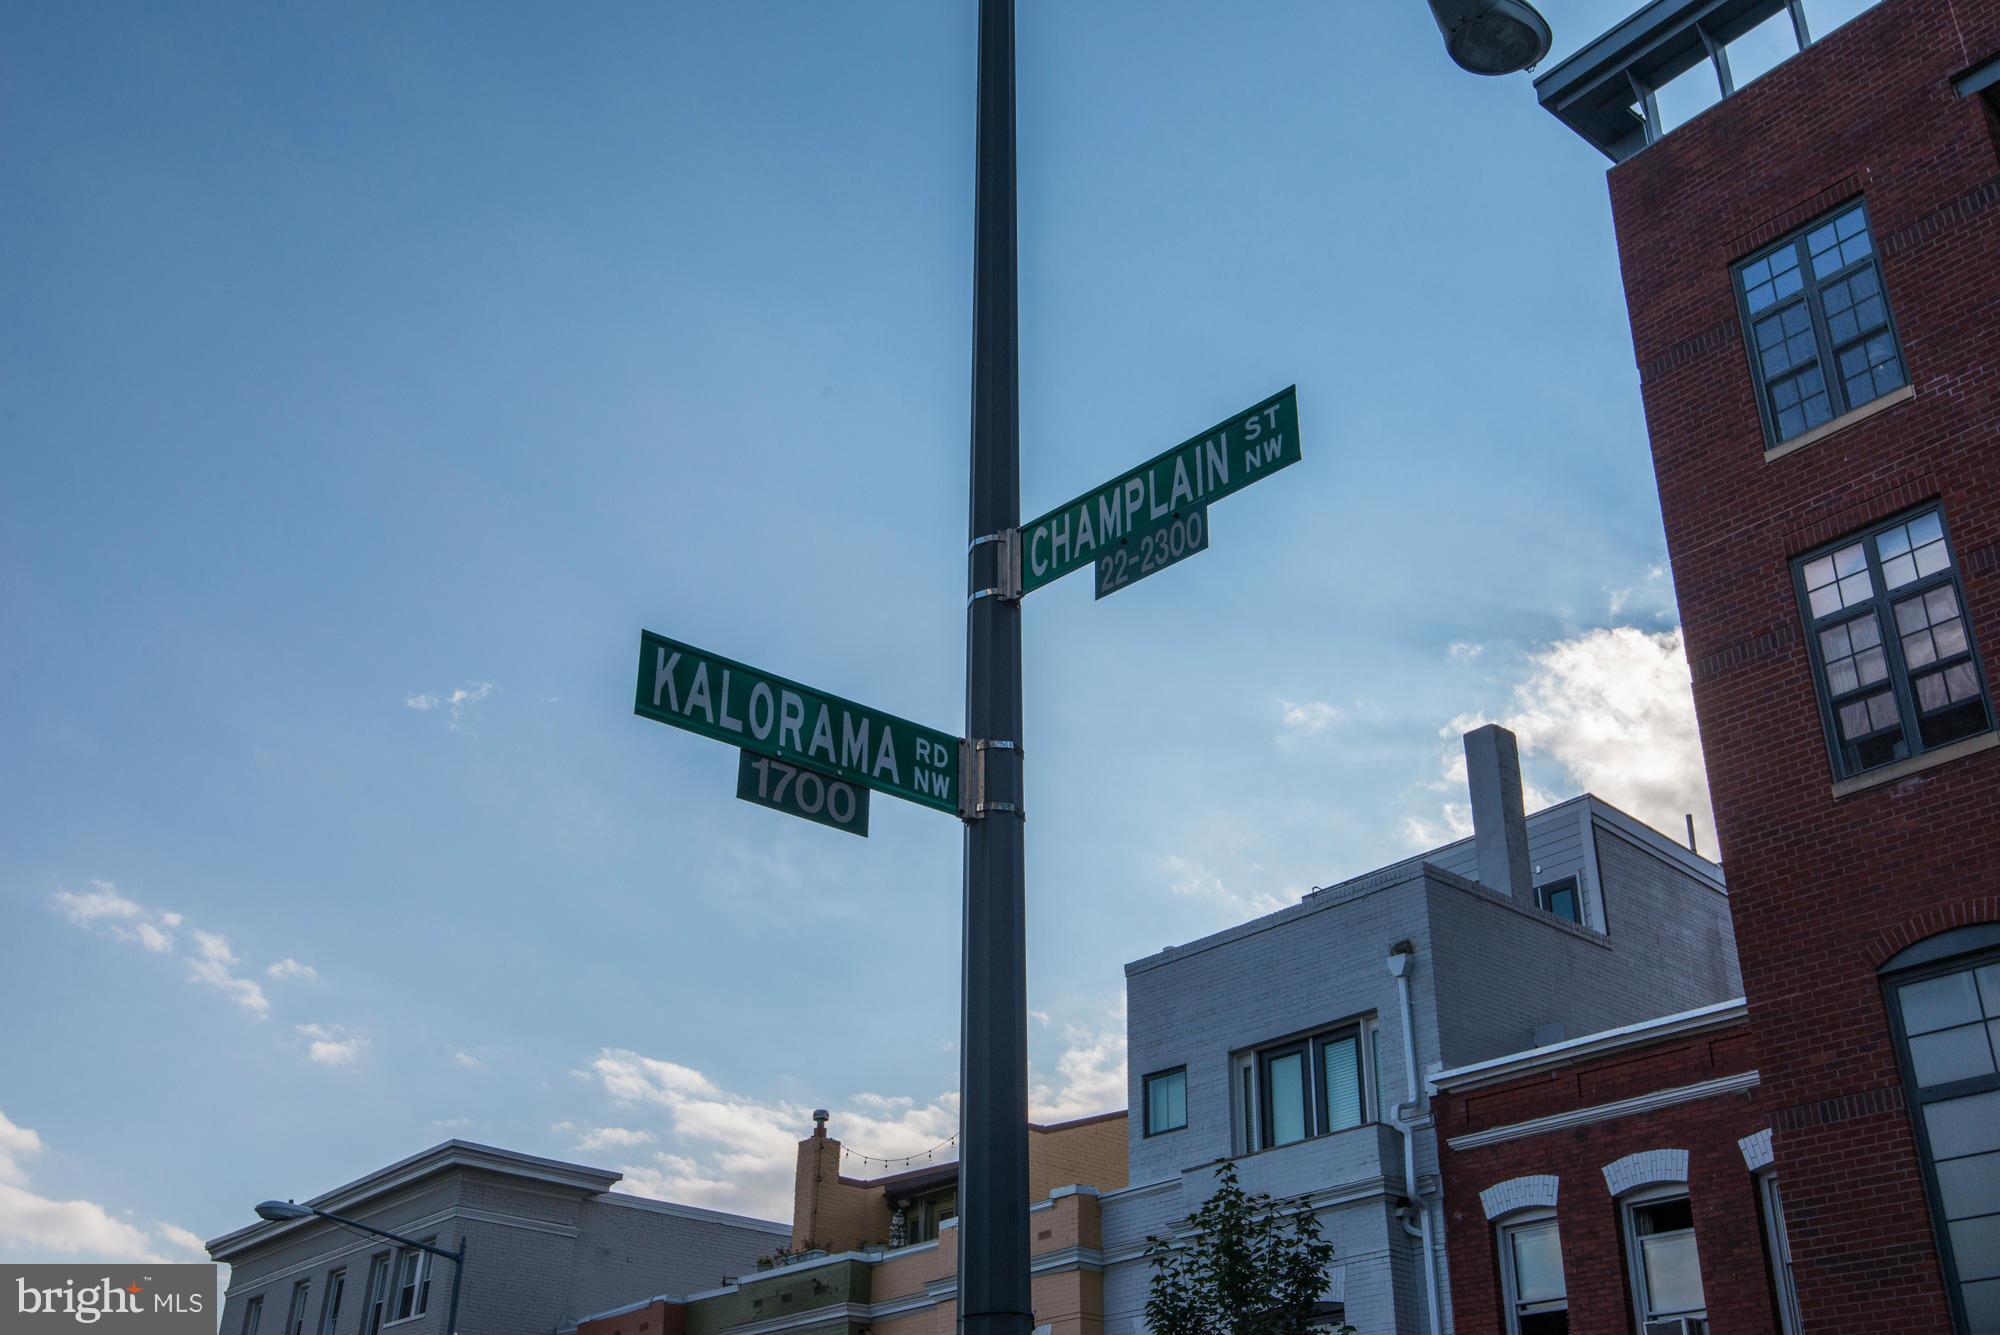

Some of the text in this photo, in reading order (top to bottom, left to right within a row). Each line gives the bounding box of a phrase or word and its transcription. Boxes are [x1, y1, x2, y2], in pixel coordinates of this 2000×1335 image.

[1244, 404, 1280, 441] ST
[1245, 433, 1283, 473] NW
[1031, 432, 1229, 577] CHAMPLAIN
[1100, 511, 1202, 593] 22-2300
[653, 647, 900, 784] KALORAMA
[915, 736, 948, 768] RD
[751, 758, 857, 824] 1700
[913, 770, 951, 800] NW
